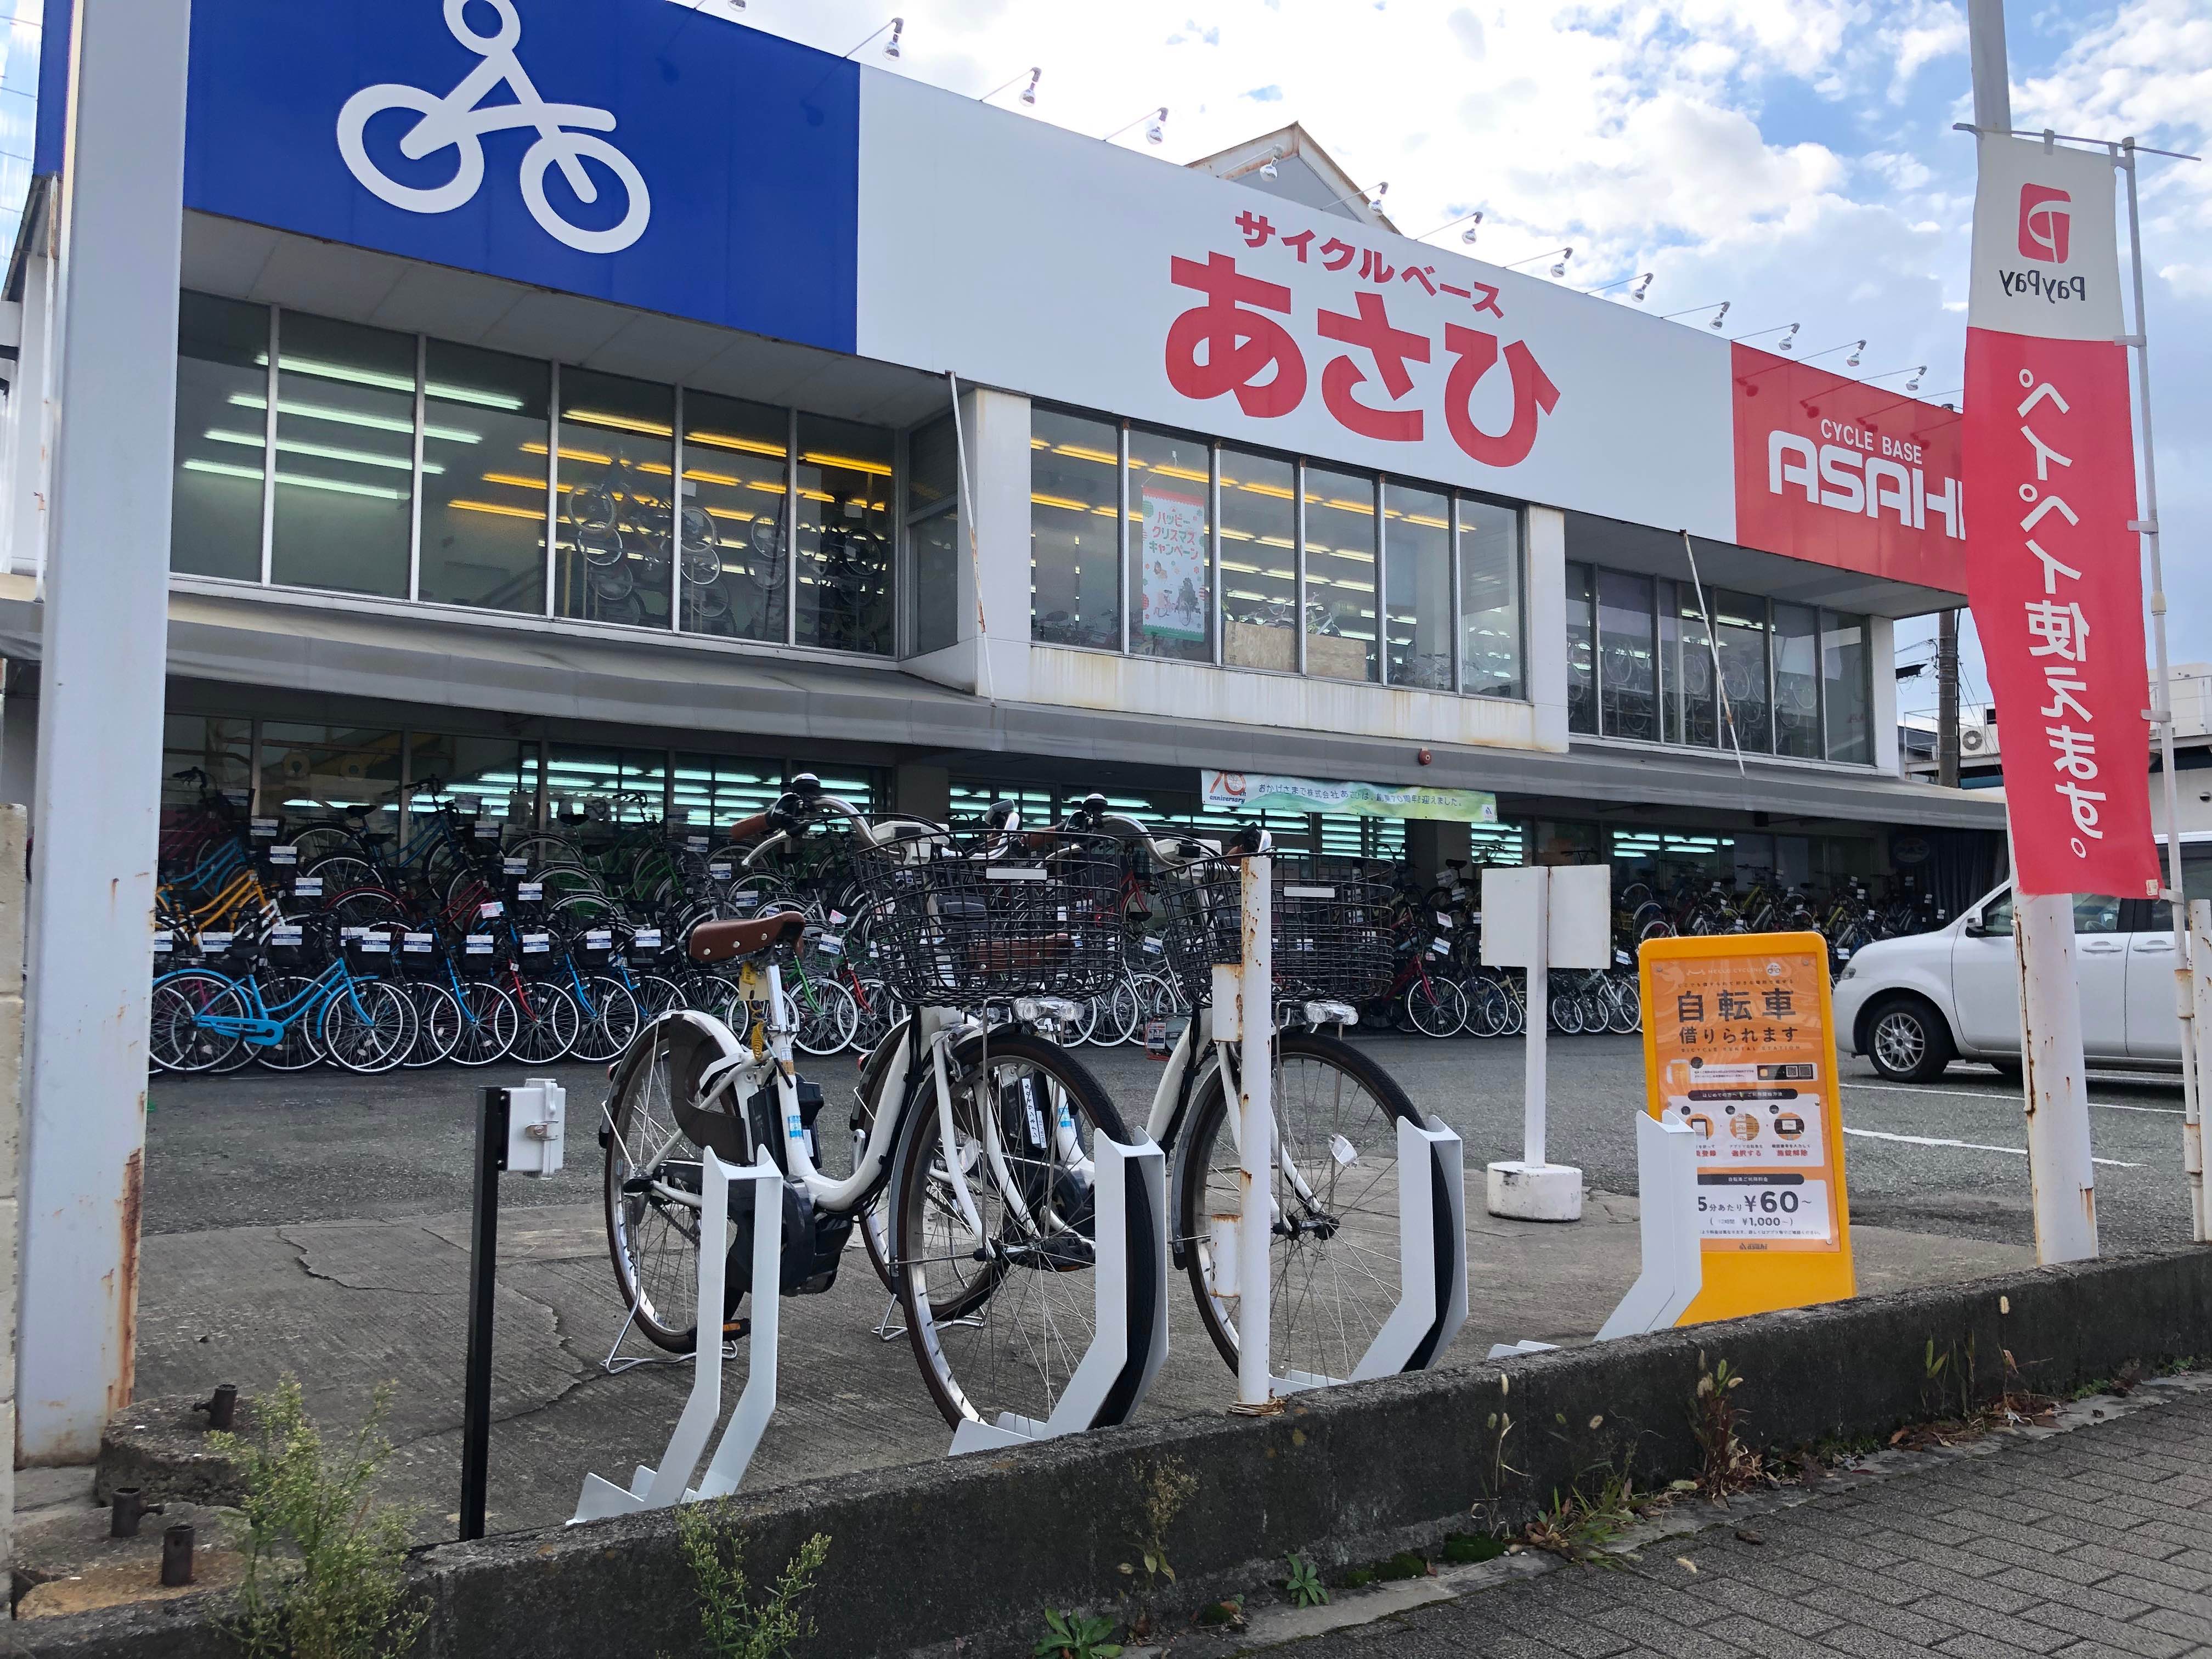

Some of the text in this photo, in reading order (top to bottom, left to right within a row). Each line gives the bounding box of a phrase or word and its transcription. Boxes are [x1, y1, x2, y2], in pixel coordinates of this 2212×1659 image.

[1235, 211, 1504, 319] サイクルベース
[1166, 251, 1561, 467] あさひ
[1820, 418, 1923, 465] CYCLE BASE
[1157, 511, 1191, 527] ハッピー
[1152, 526, 1195, 545] クリスマス
[1149, 540, 1198, 560] キャンペーン
[1677, 988, 1796, 1023] 自転車
[1679, 1026, 1798, 1044] 借りられます
